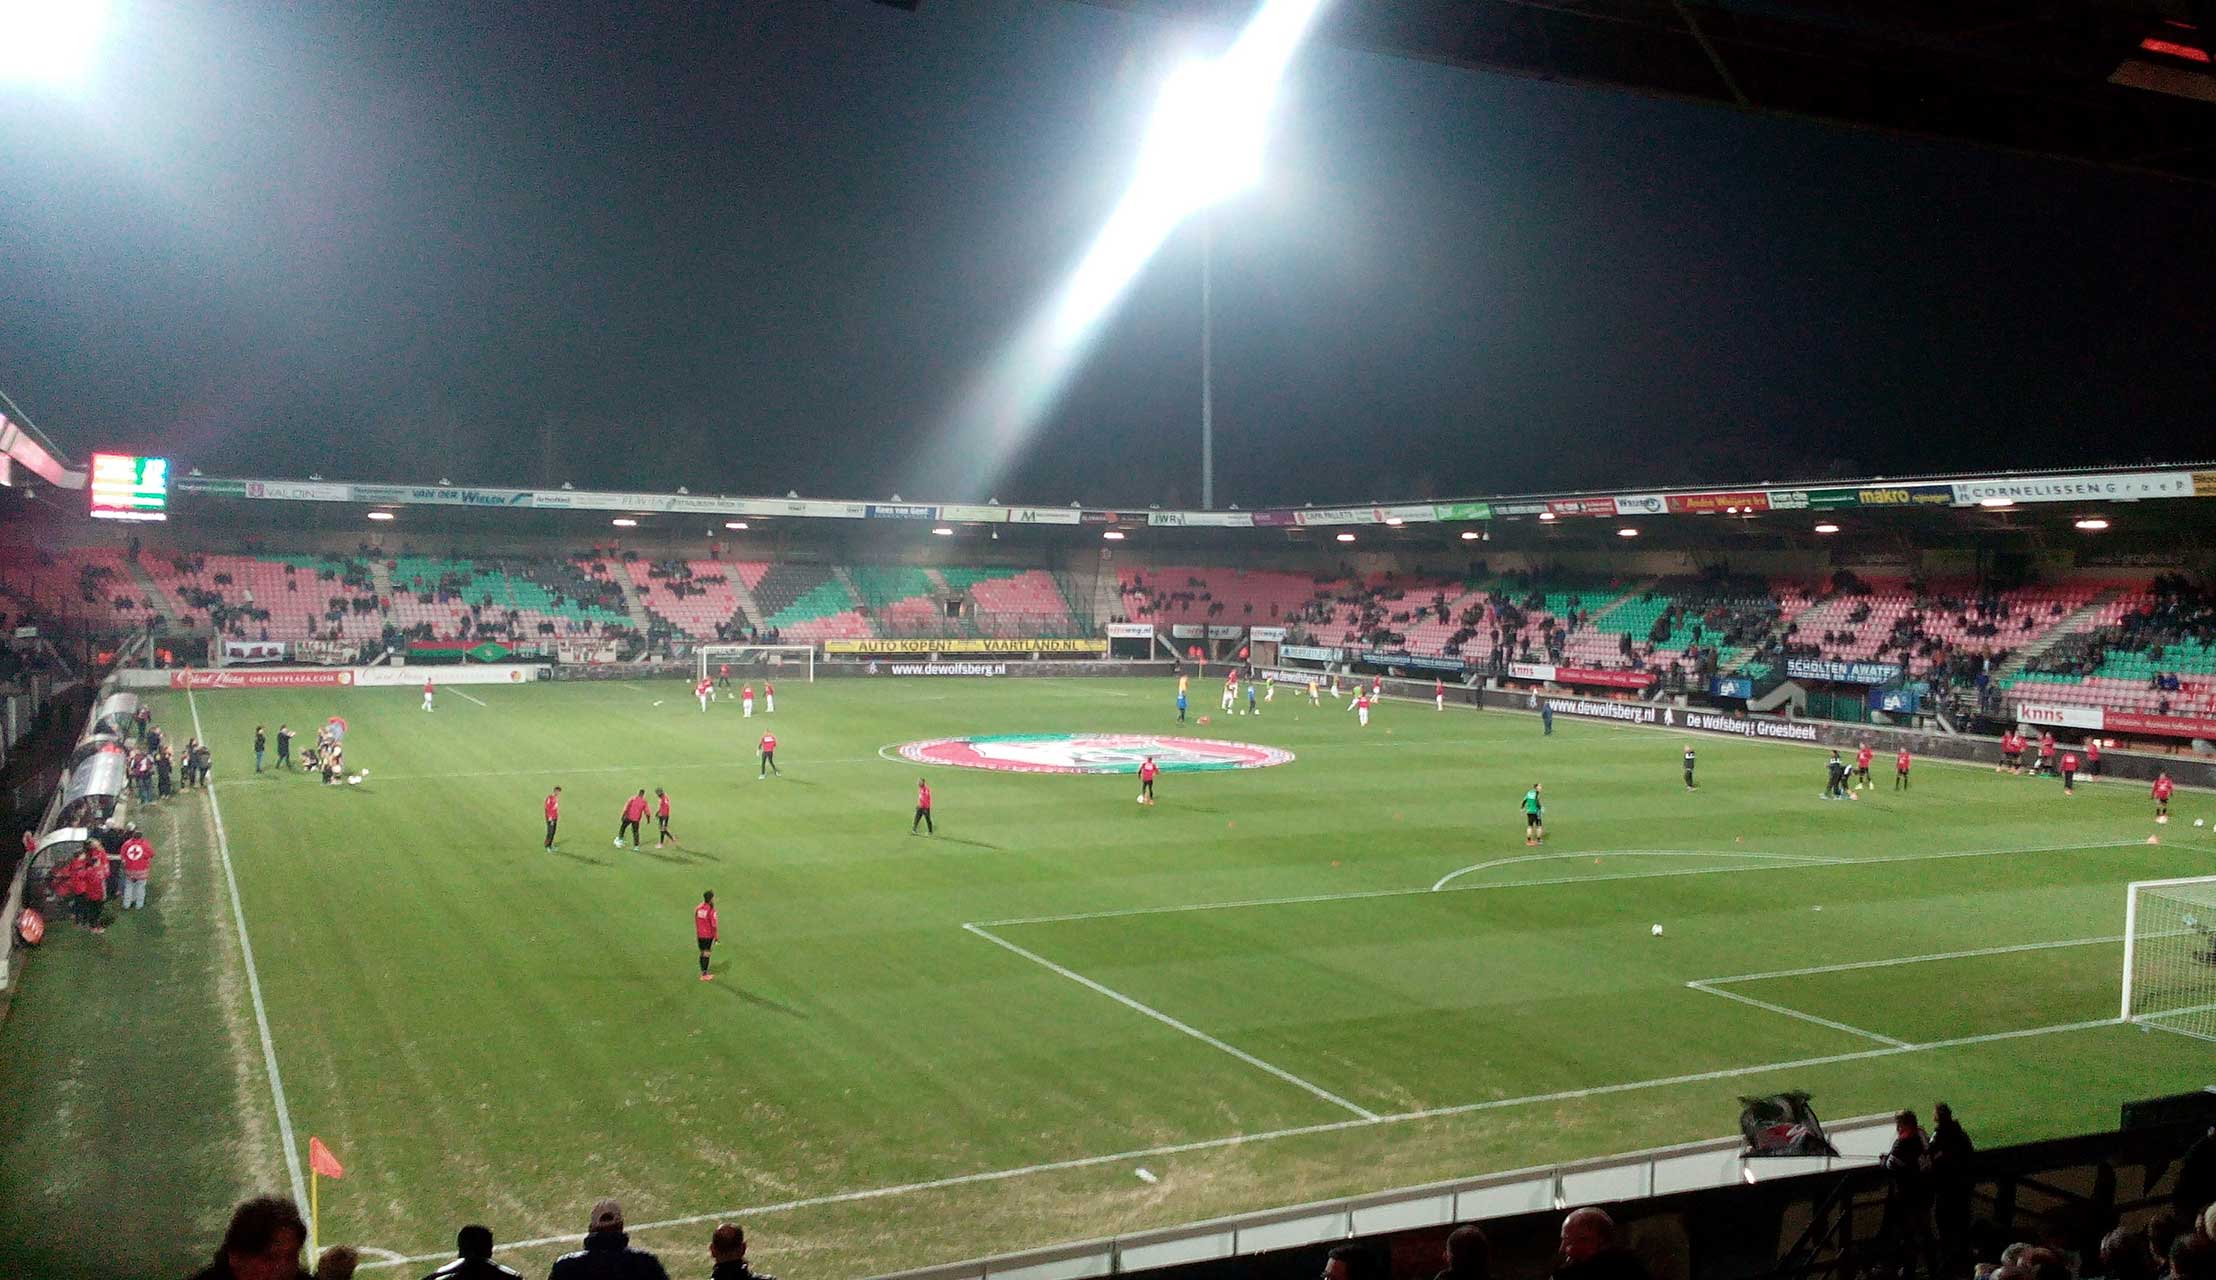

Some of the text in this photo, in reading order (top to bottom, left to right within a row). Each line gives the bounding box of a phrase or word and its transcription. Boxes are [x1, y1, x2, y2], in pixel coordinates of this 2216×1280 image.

[1858, 489, 1910, 505] makro
[1972, 481, 2100, 498] CORNELISSEN
[858, 640, 896, 652] AUTO
[983, 640, 1079, 652] VAARTLAND.NL
[891, 663, 1005, 676] www.dewolfsberg.nl
[1787, 660, 1848, 675] SCHOLTEN
[1549, 700, 1655, 723] www.dewolfsberg.nl
[1687, 713, 1701, 728] De
[1757, 721, 1817, 740] Groesbeek
[2022, 705, 2064, 722] knns
